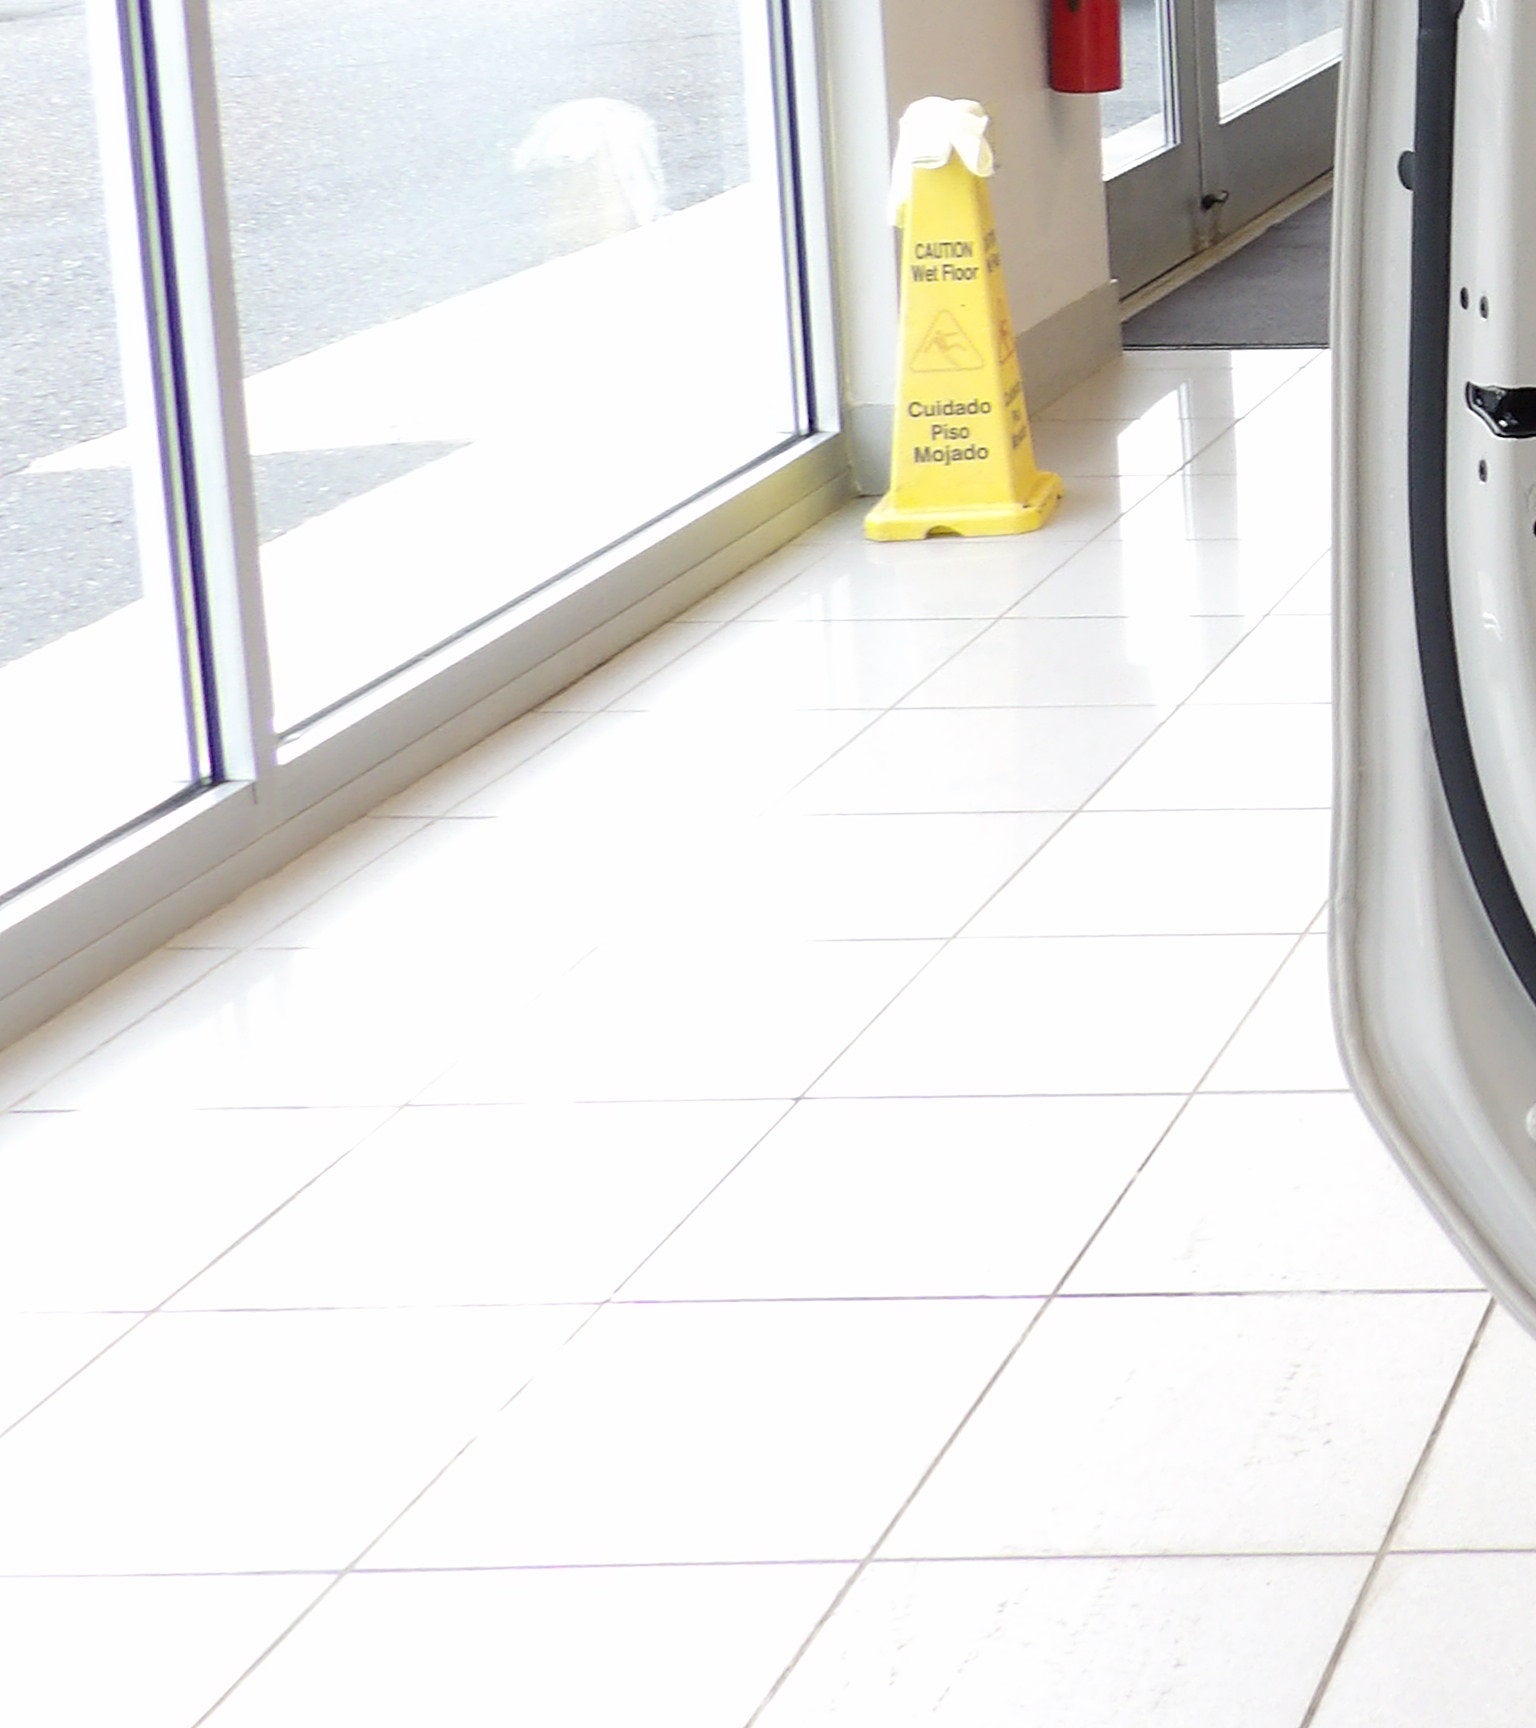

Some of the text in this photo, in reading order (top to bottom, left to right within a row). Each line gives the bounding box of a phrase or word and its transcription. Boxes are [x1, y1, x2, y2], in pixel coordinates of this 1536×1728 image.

[914, 241, 973, 260] CAUTION
[911, 264, 938, 282] Wet
[942, 263, 979, 281] Floor
[908, 399, 992, 418] Cuidado
[931, 423, 970, 441] Piso
[914, 443, 989, 466] Mojado
